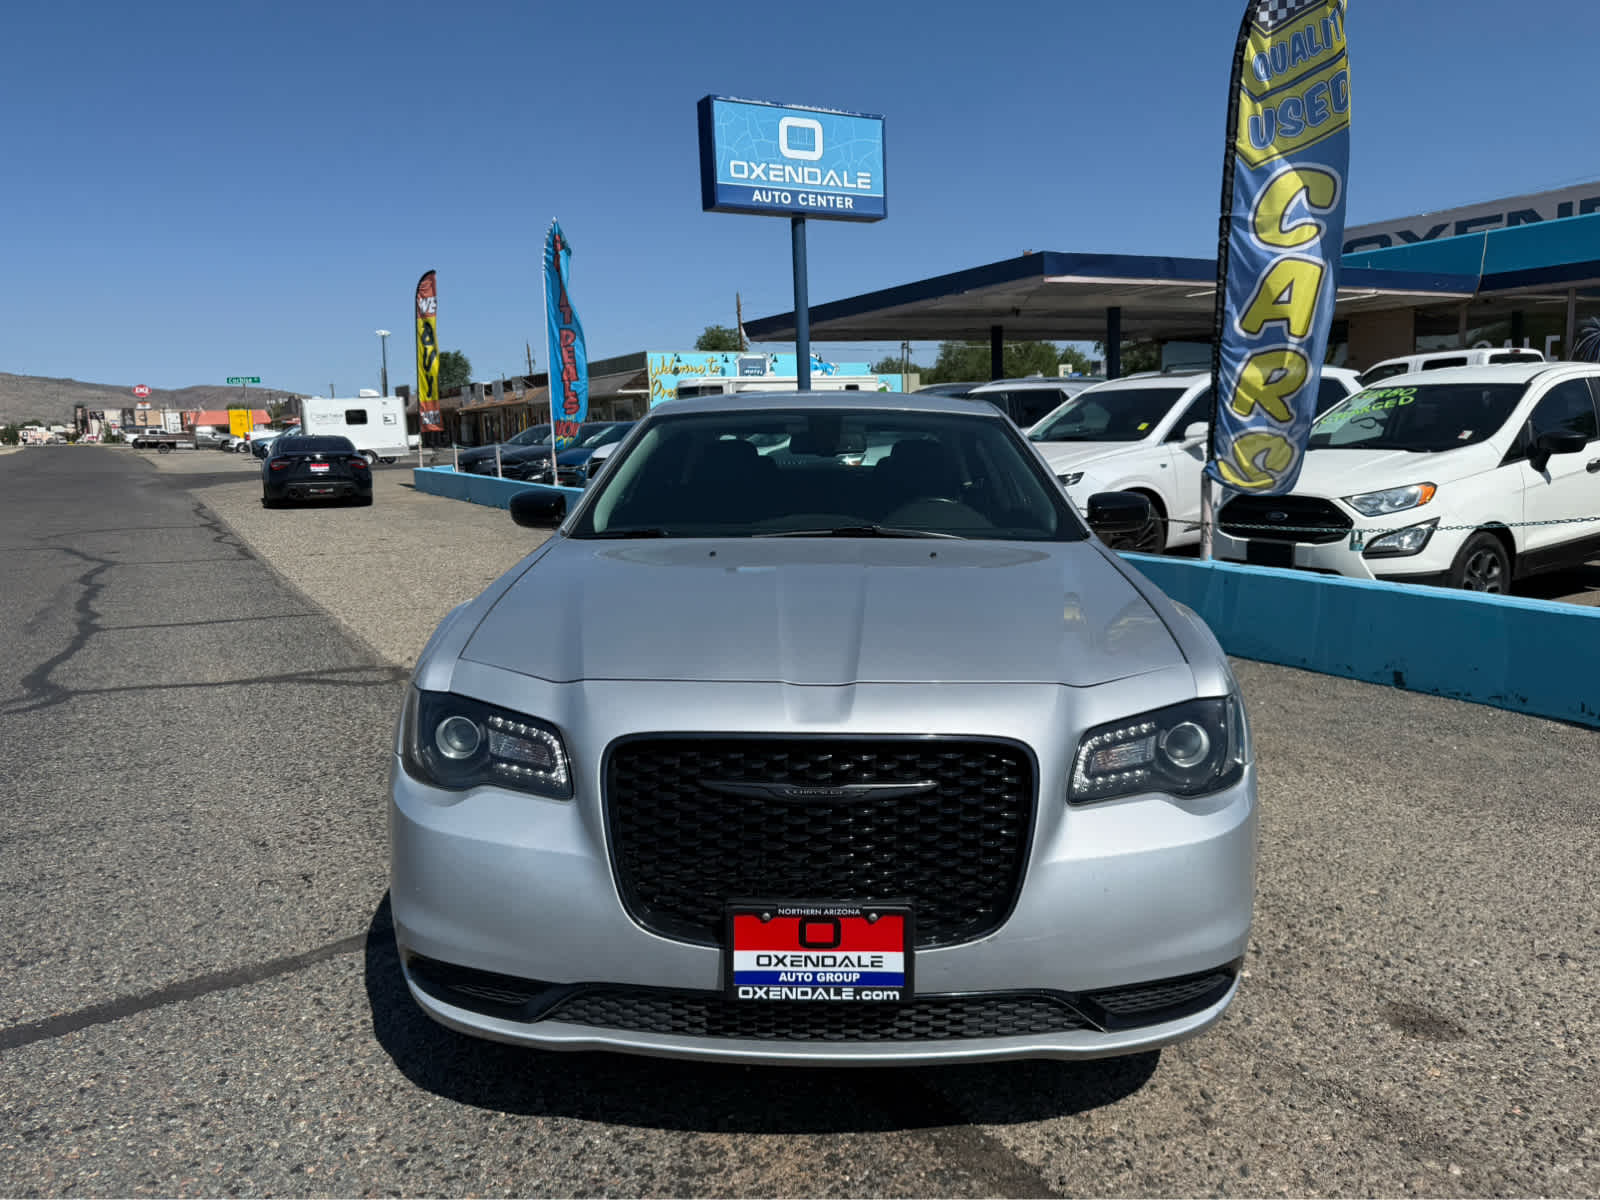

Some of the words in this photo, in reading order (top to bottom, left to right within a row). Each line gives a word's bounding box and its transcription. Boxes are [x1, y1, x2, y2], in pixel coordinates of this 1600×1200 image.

[1247, 69, 1349, 150] USED
[729, 159, 872, 190] OXENDALE
[752, 189, 792, 204] AUTO
[798, 193, 854, 209] CENTER
[418, 297, 437, 314] WE
[1215, 162, 1342, 492] CARS
[559, 327, 580, 415] DEALS
[706, 356, 720, 374] to
[778, 908, 822, 916] NORTHERN
[823, 908, 861, 916] ARIZONA
[755, 954, 884, 968] OXENDALE
[778, 972, 813, 983] AUTO
[816, 972, 861, 983] GROUP
[738, 986, 900, 1001] OXENDALE.com
